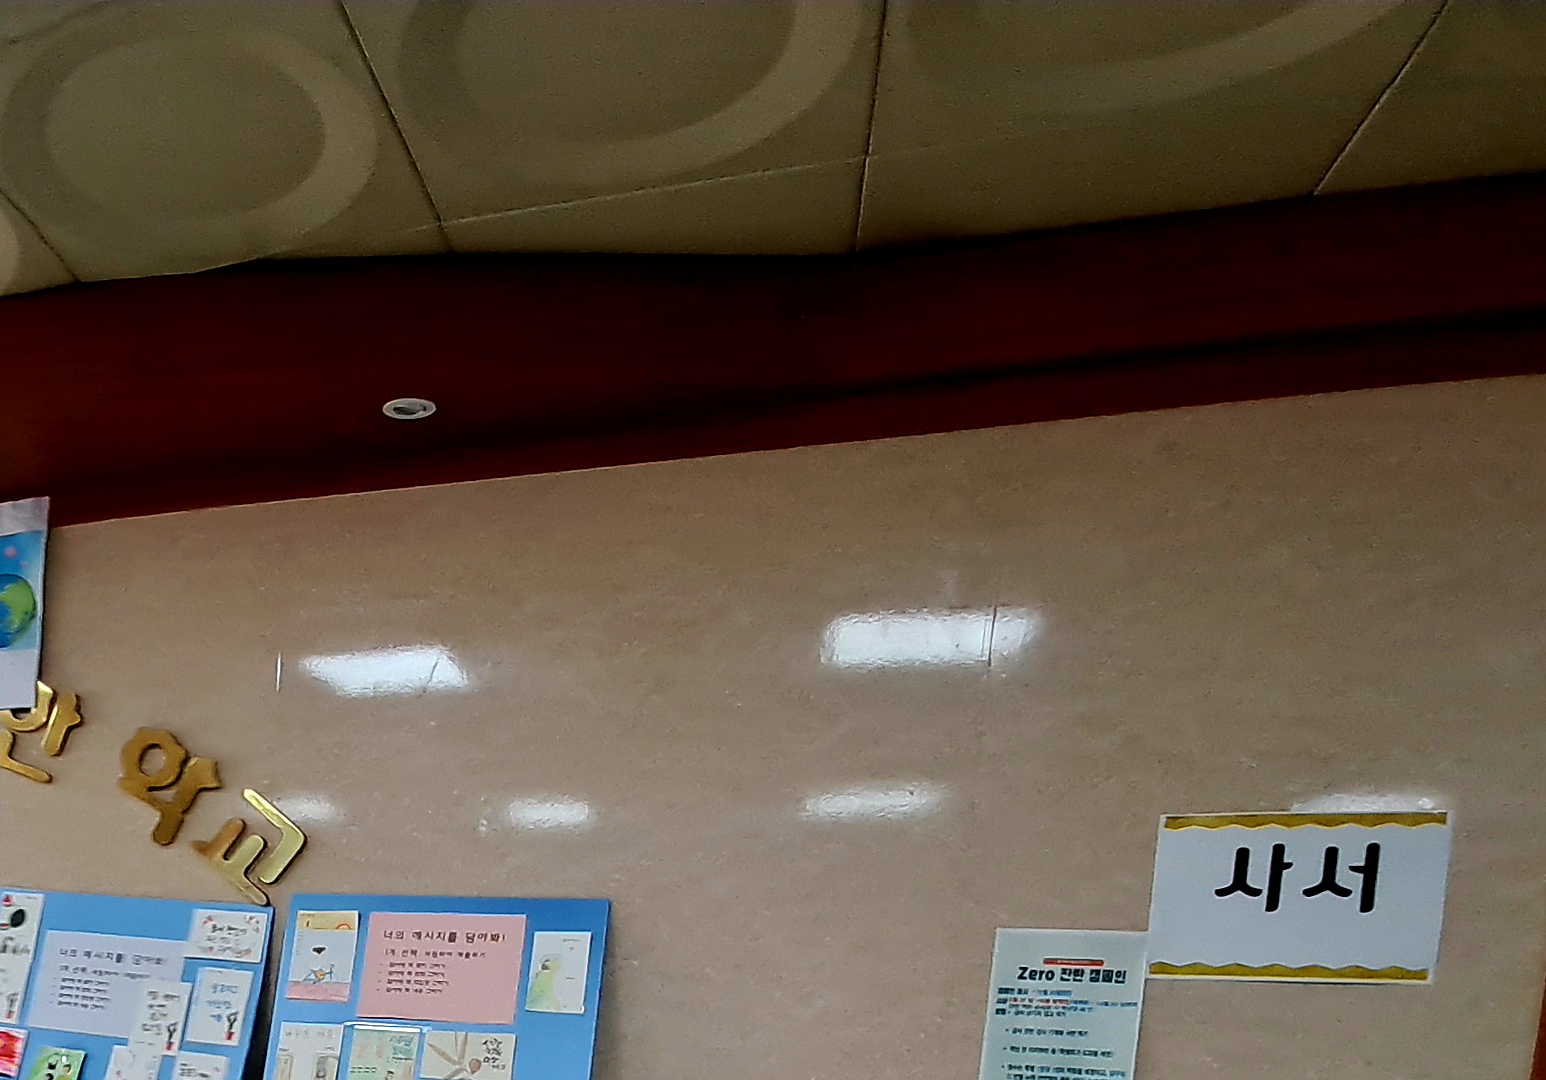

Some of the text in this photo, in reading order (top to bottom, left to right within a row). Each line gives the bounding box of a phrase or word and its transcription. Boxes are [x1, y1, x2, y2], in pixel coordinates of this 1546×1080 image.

[1214, 842, 1382, 915] 사서
[383, 930, 405, 940] 너의
[412, 931, 457, 943] 메시지를
[1017, 966, 1055, 982] Zero
